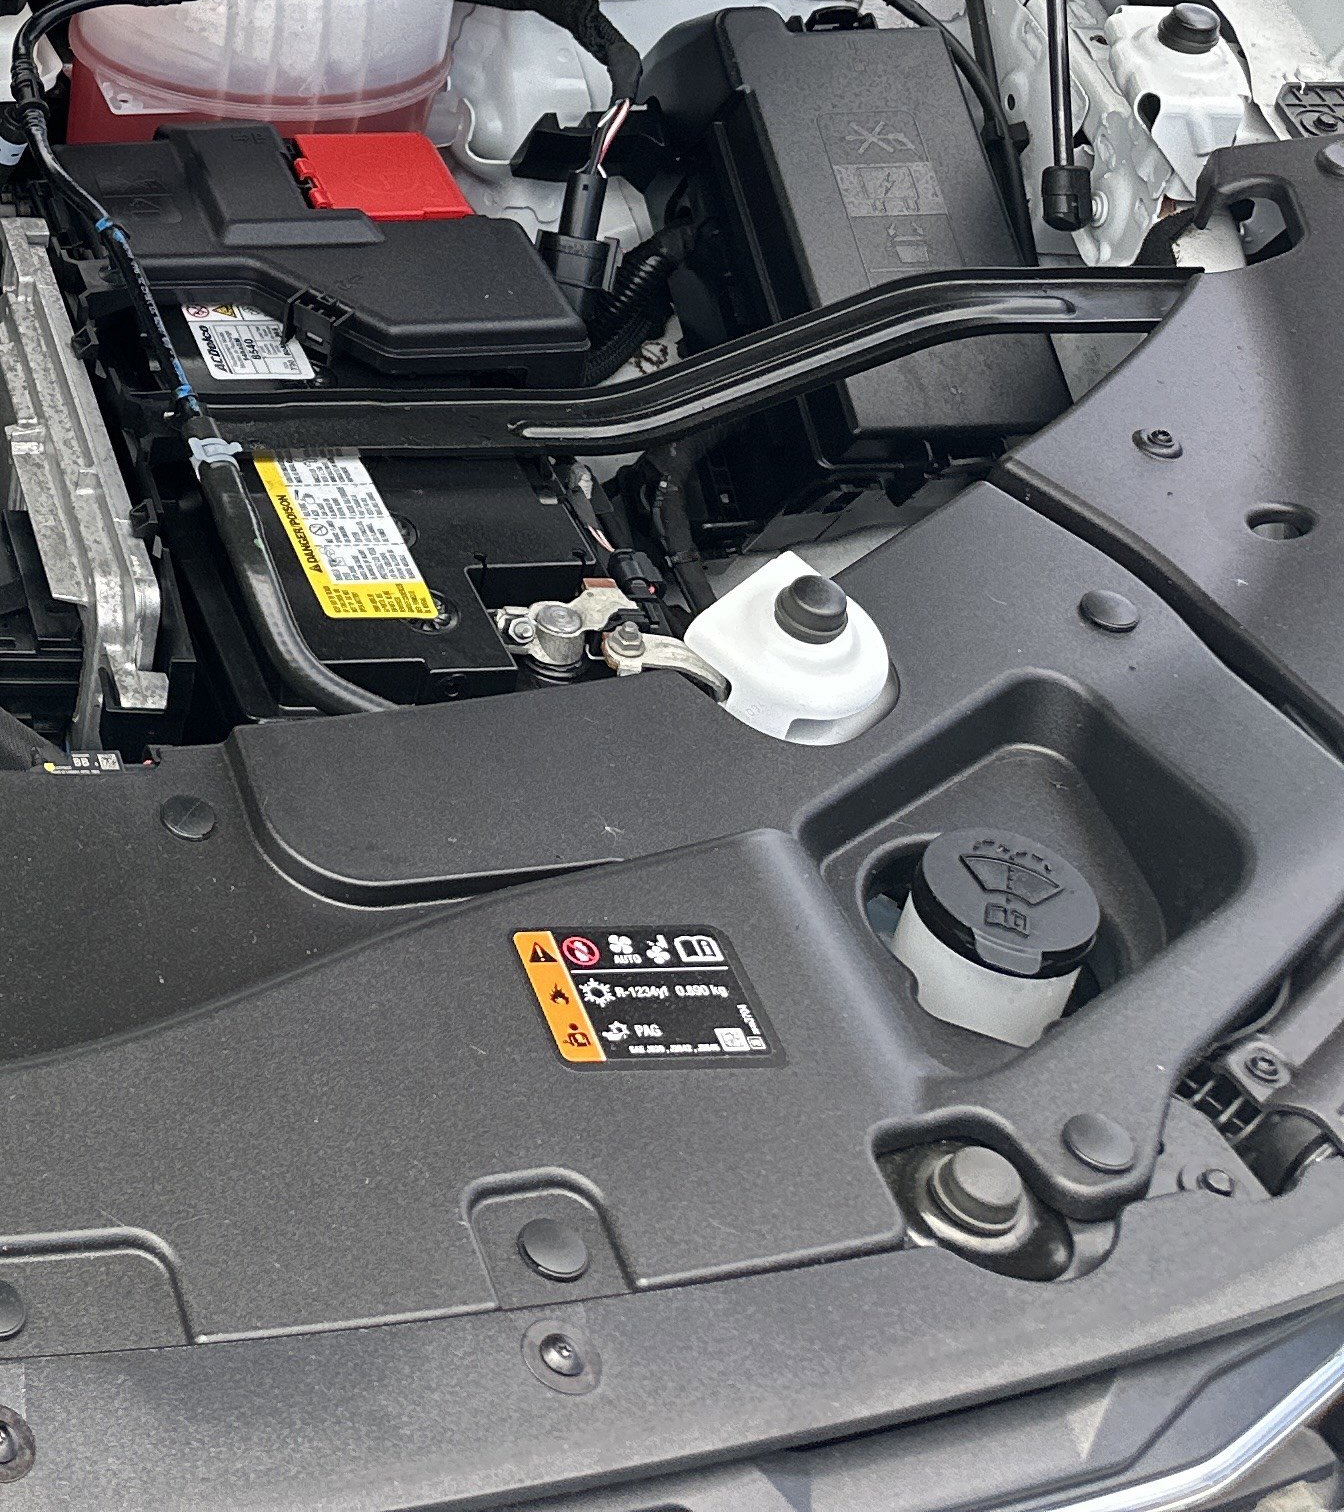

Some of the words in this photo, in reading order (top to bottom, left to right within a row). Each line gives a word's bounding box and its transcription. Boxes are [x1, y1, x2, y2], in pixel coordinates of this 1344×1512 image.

[199, 325, 228, 372] ACDelco
[614, 954, 642, 964] AUTO
[710, 984, 729, 998] kg
[634, 1024, 663, 1037] PAG
